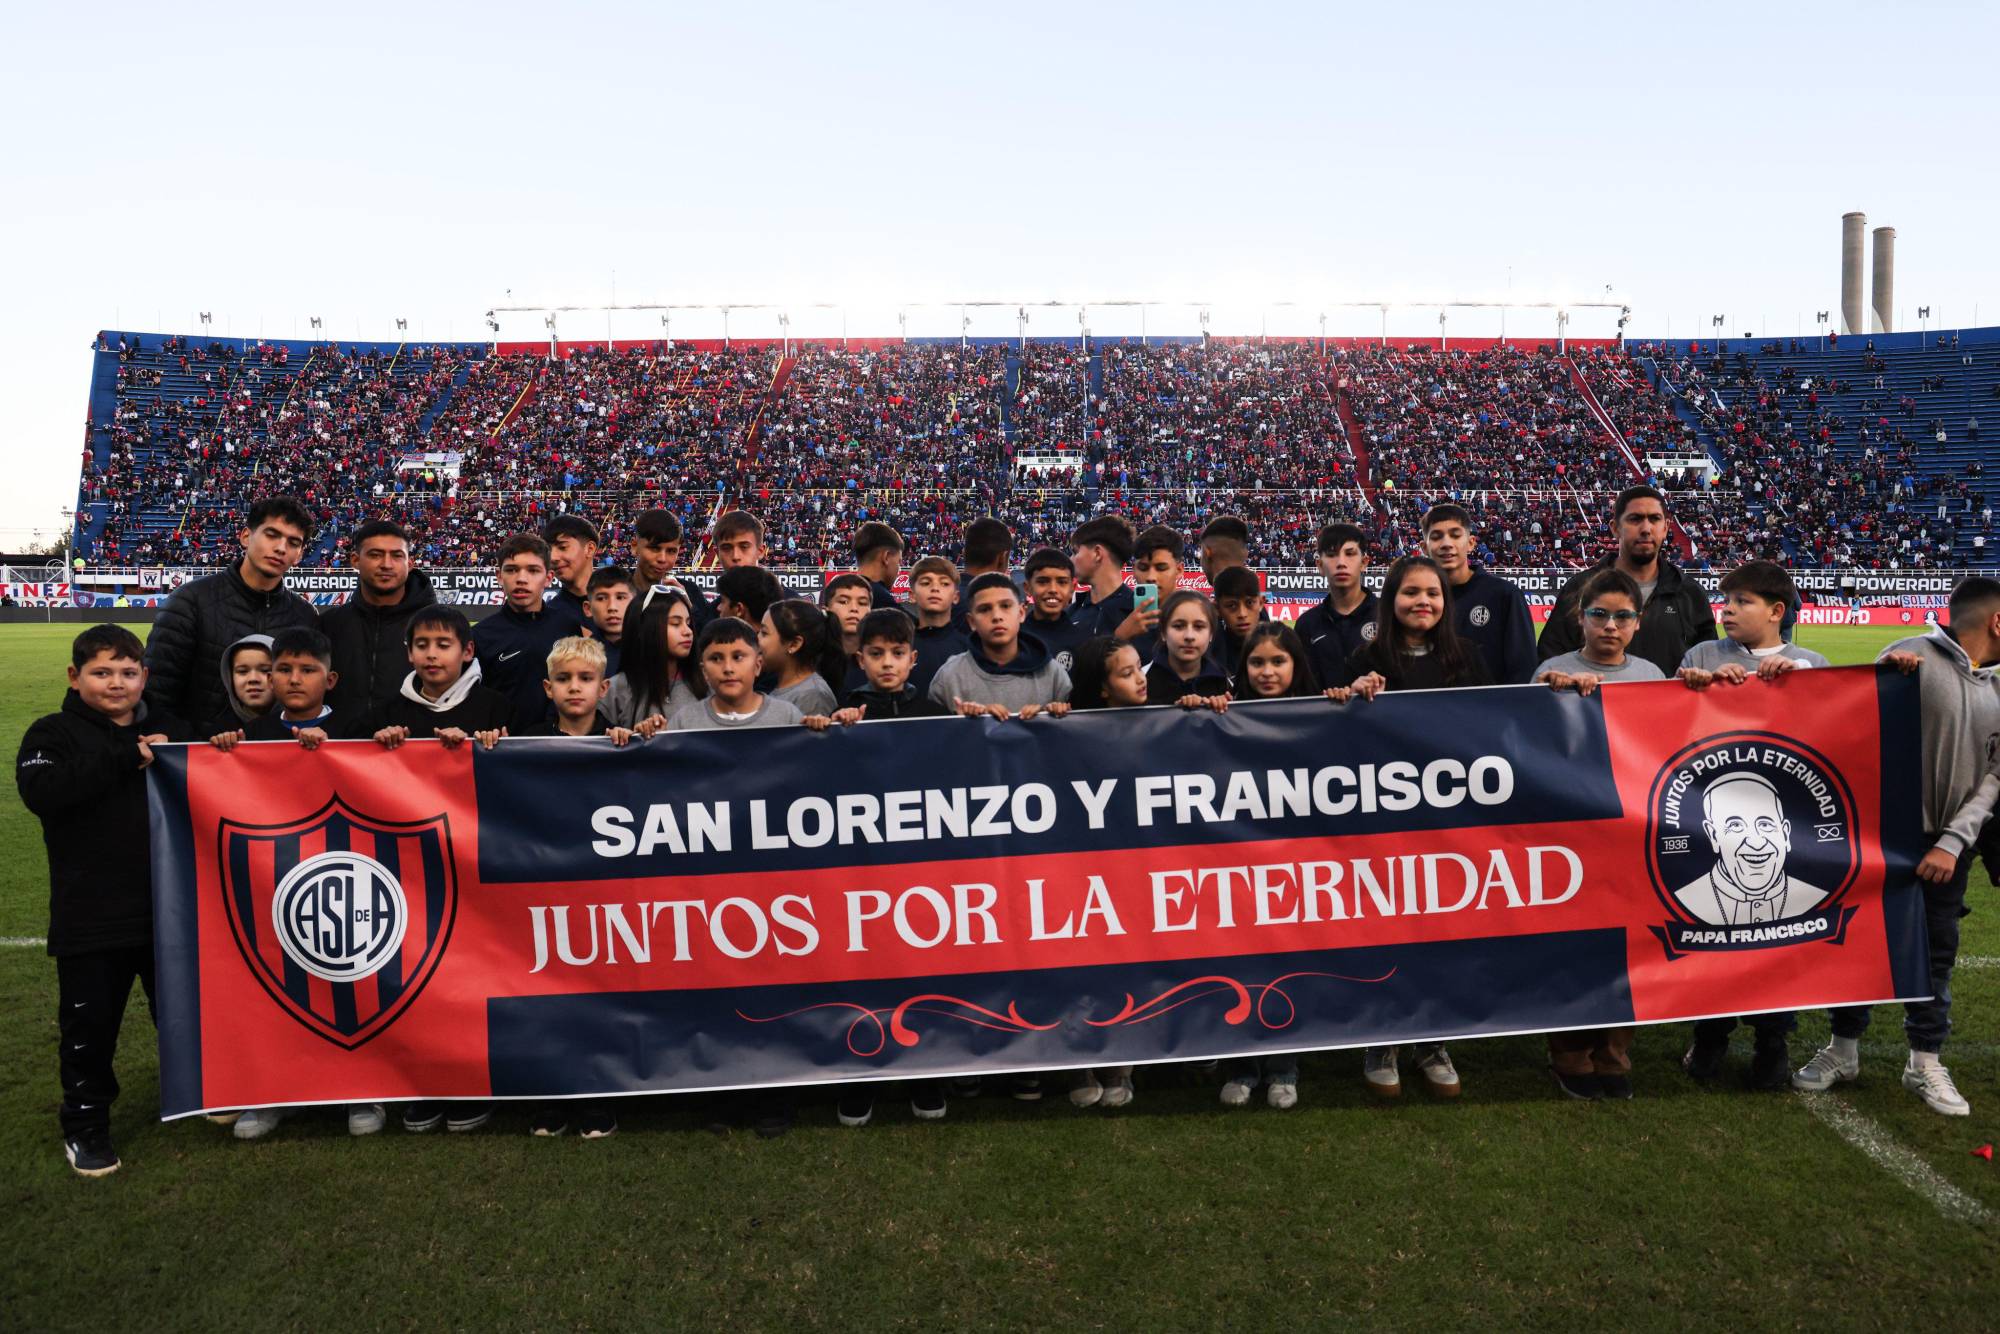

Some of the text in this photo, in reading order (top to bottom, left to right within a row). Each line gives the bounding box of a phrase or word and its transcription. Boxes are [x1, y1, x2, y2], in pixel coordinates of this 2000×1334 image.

[284, 576, 358, 589] OWERADE
[591, 755, 1514, 858] SAN LORENZO Y FRANCISCO
[1665, 747, 1836, 829] JUNTOS POR LA ETERNIDAD
[1664, 838, 1688, 851] 1936
[528, 845, 1584, 973] JUNTOS POR LA ETERNIDAD
[1680, 917, 1828, 944] PAPA FRANCISCO
